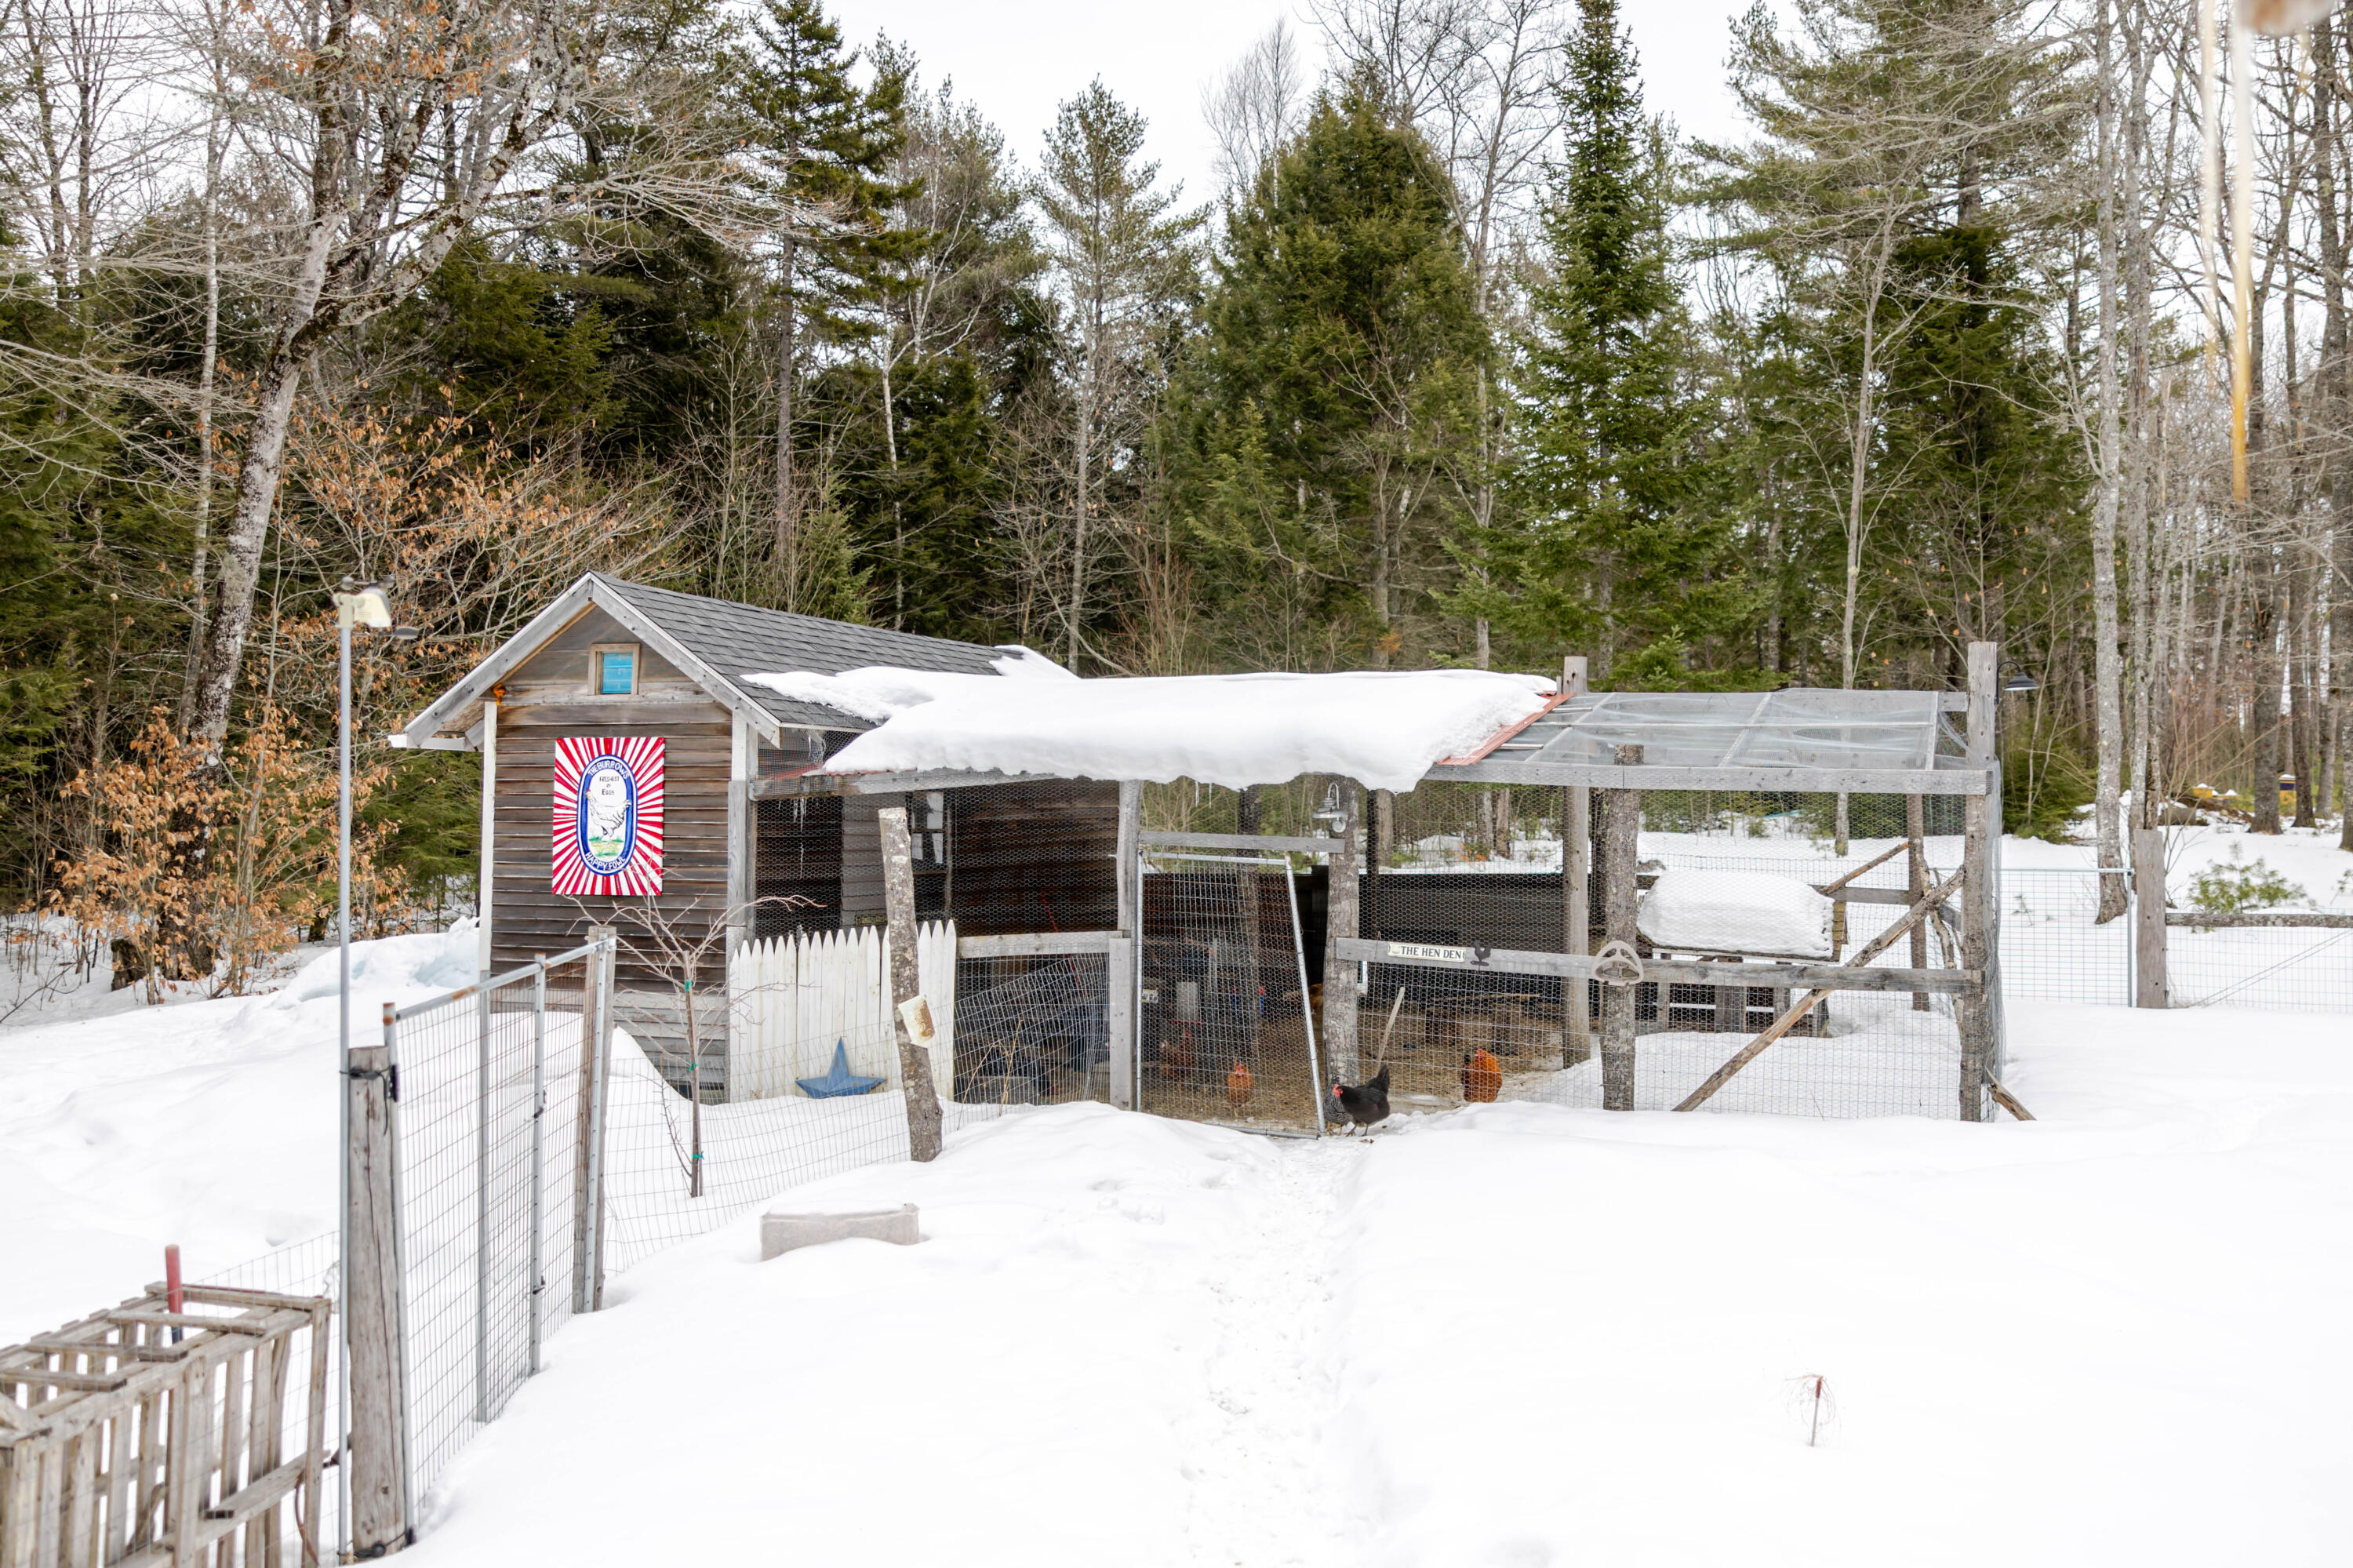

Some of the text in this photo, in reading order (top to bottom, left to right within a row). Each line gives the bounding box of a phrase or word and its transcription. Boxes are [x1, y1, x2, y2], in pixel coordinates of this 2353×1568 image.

[588, 760, 630, 779] THE BURROWS
[585, 851, 626, 871] HAPPY FOWL
[1401, 946, 1461, 959] THE HEN DEN
